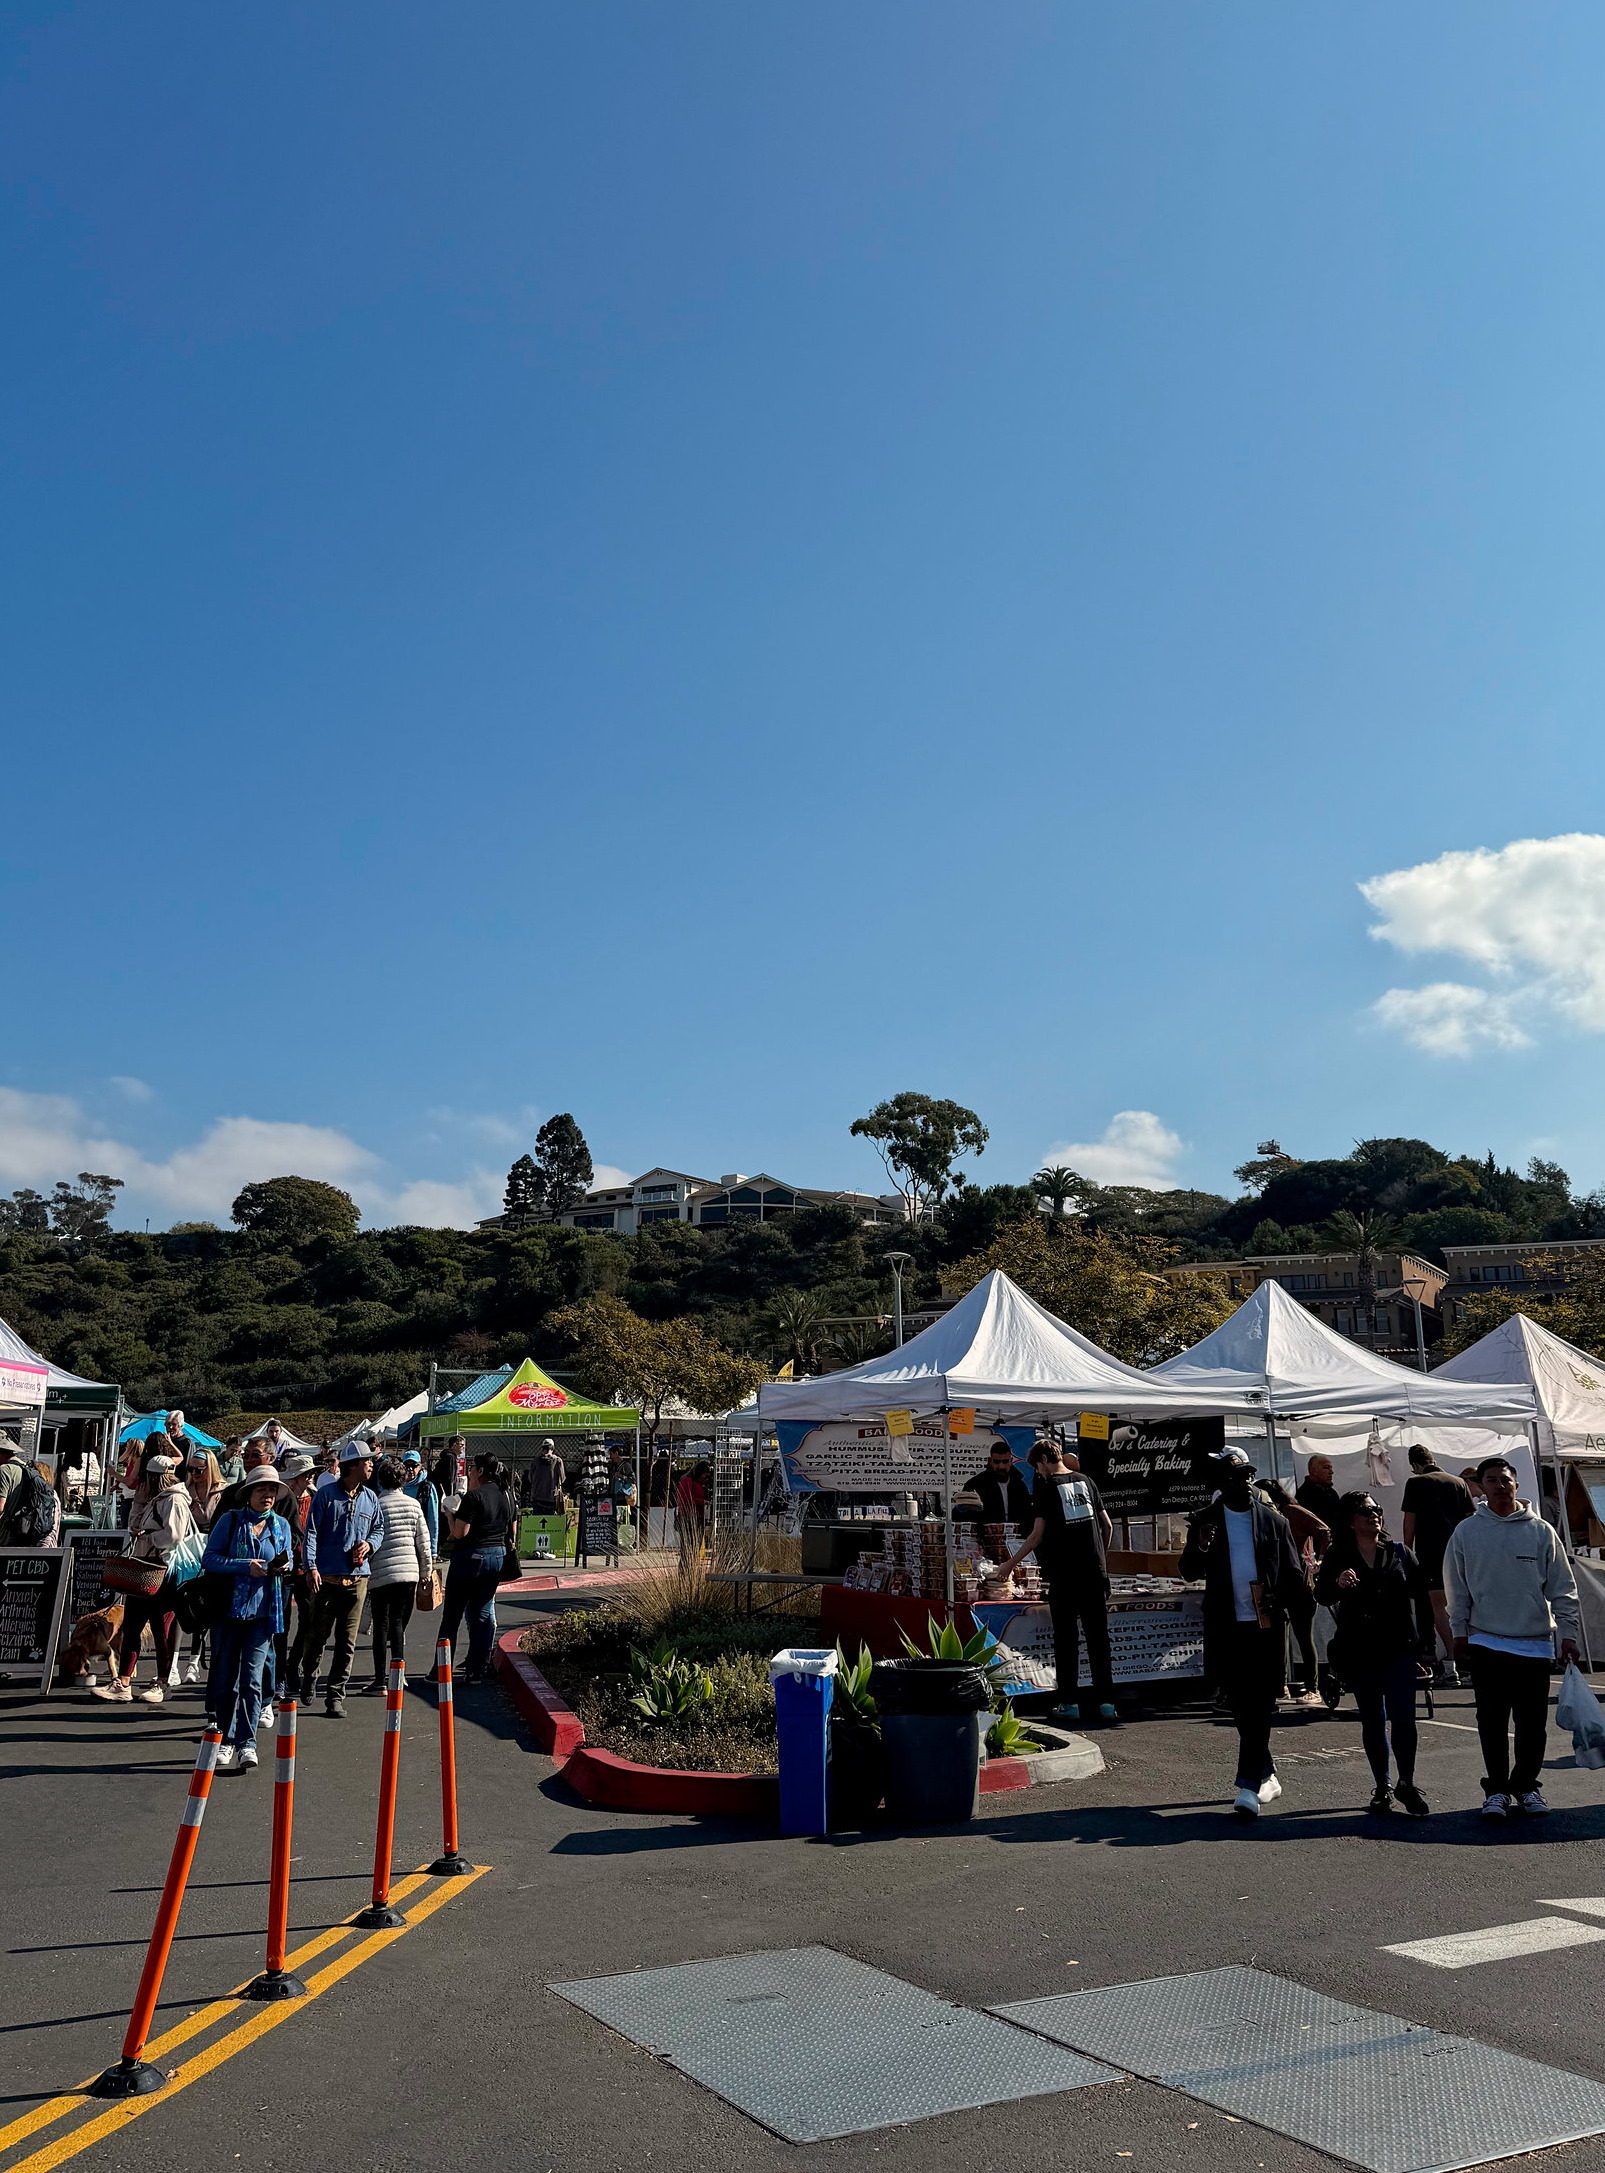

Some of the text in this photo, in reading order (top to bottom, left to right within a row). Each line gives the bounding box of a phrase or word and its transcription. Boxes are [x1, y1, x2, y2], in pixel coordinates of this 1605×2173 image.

[500, 1413, 602, 1429] INFORMATION
[1137, 1434, 1179, 1453] Catering
[1181, 1432, 1191, 1446] &
[1107, 1453, 1192, 1478] Specialty Baking
[6, 1559, 50, 1574] PET CBD
[1126, 1602, 1176, 1611] FOODS
[1148, 1621, 1204, 1631] YOGUR
[0, 1632, 36, 1647] eizures
[1168, 1648, 1203, 1656] CHIP
